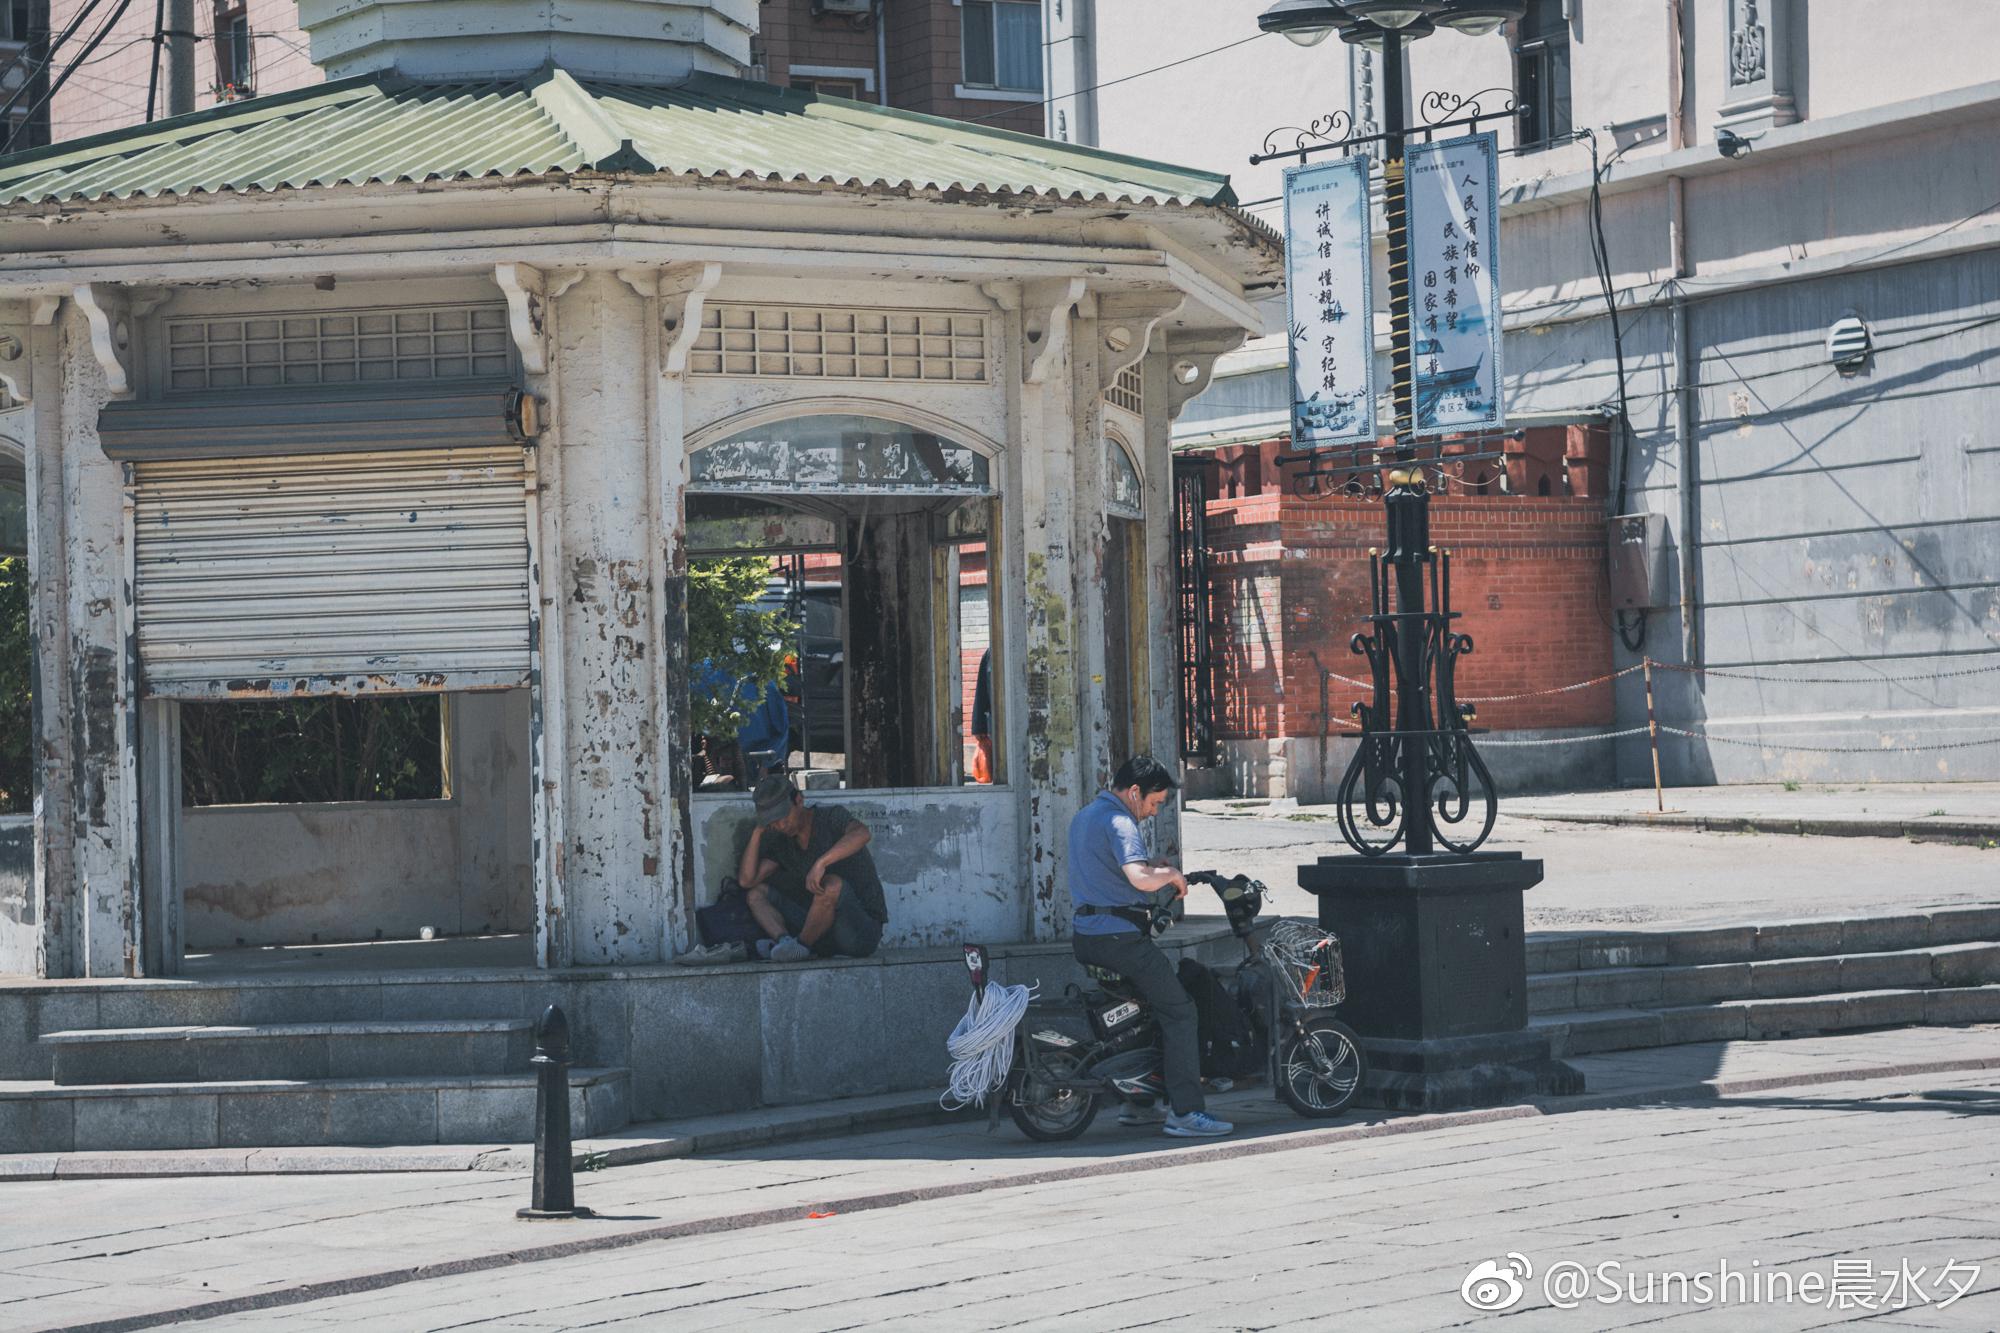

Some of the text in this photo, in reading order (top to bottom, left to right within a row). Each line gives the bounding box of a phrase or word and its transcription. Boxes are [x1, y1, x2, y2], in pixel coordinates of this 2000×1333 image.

[1442, 222, 1460, 331] 民族有希望
[1462, 174, 1479, 281] 人民有信仰
[1315, 200, 1337, 392] 讲诚信 懂规矩 守纪律
[1423, 270, 1441, 377] 国家有力量
